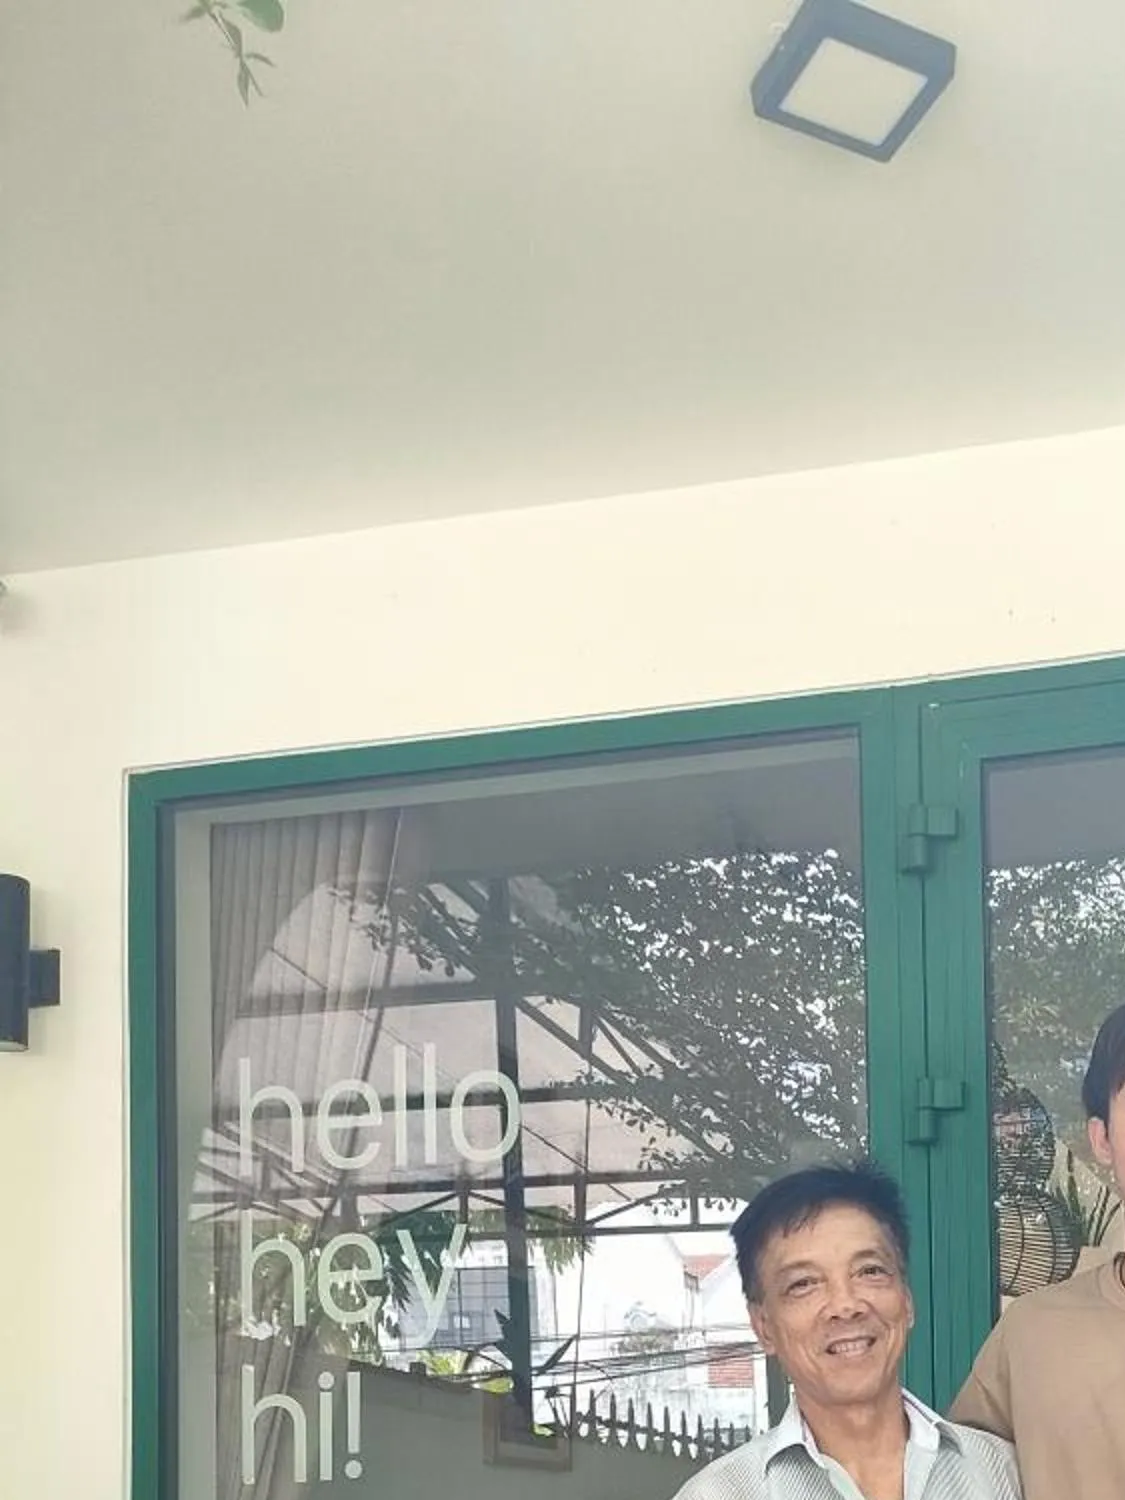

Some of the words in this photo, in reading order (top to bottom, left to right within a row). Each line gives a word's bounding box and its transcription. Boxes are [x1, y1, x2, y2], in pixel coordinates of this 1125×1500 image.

[239, 1042, 522, 1177] hello
[241, 1208, 468, 1347] hey
[241, 1364, 363, 1485] hi!
